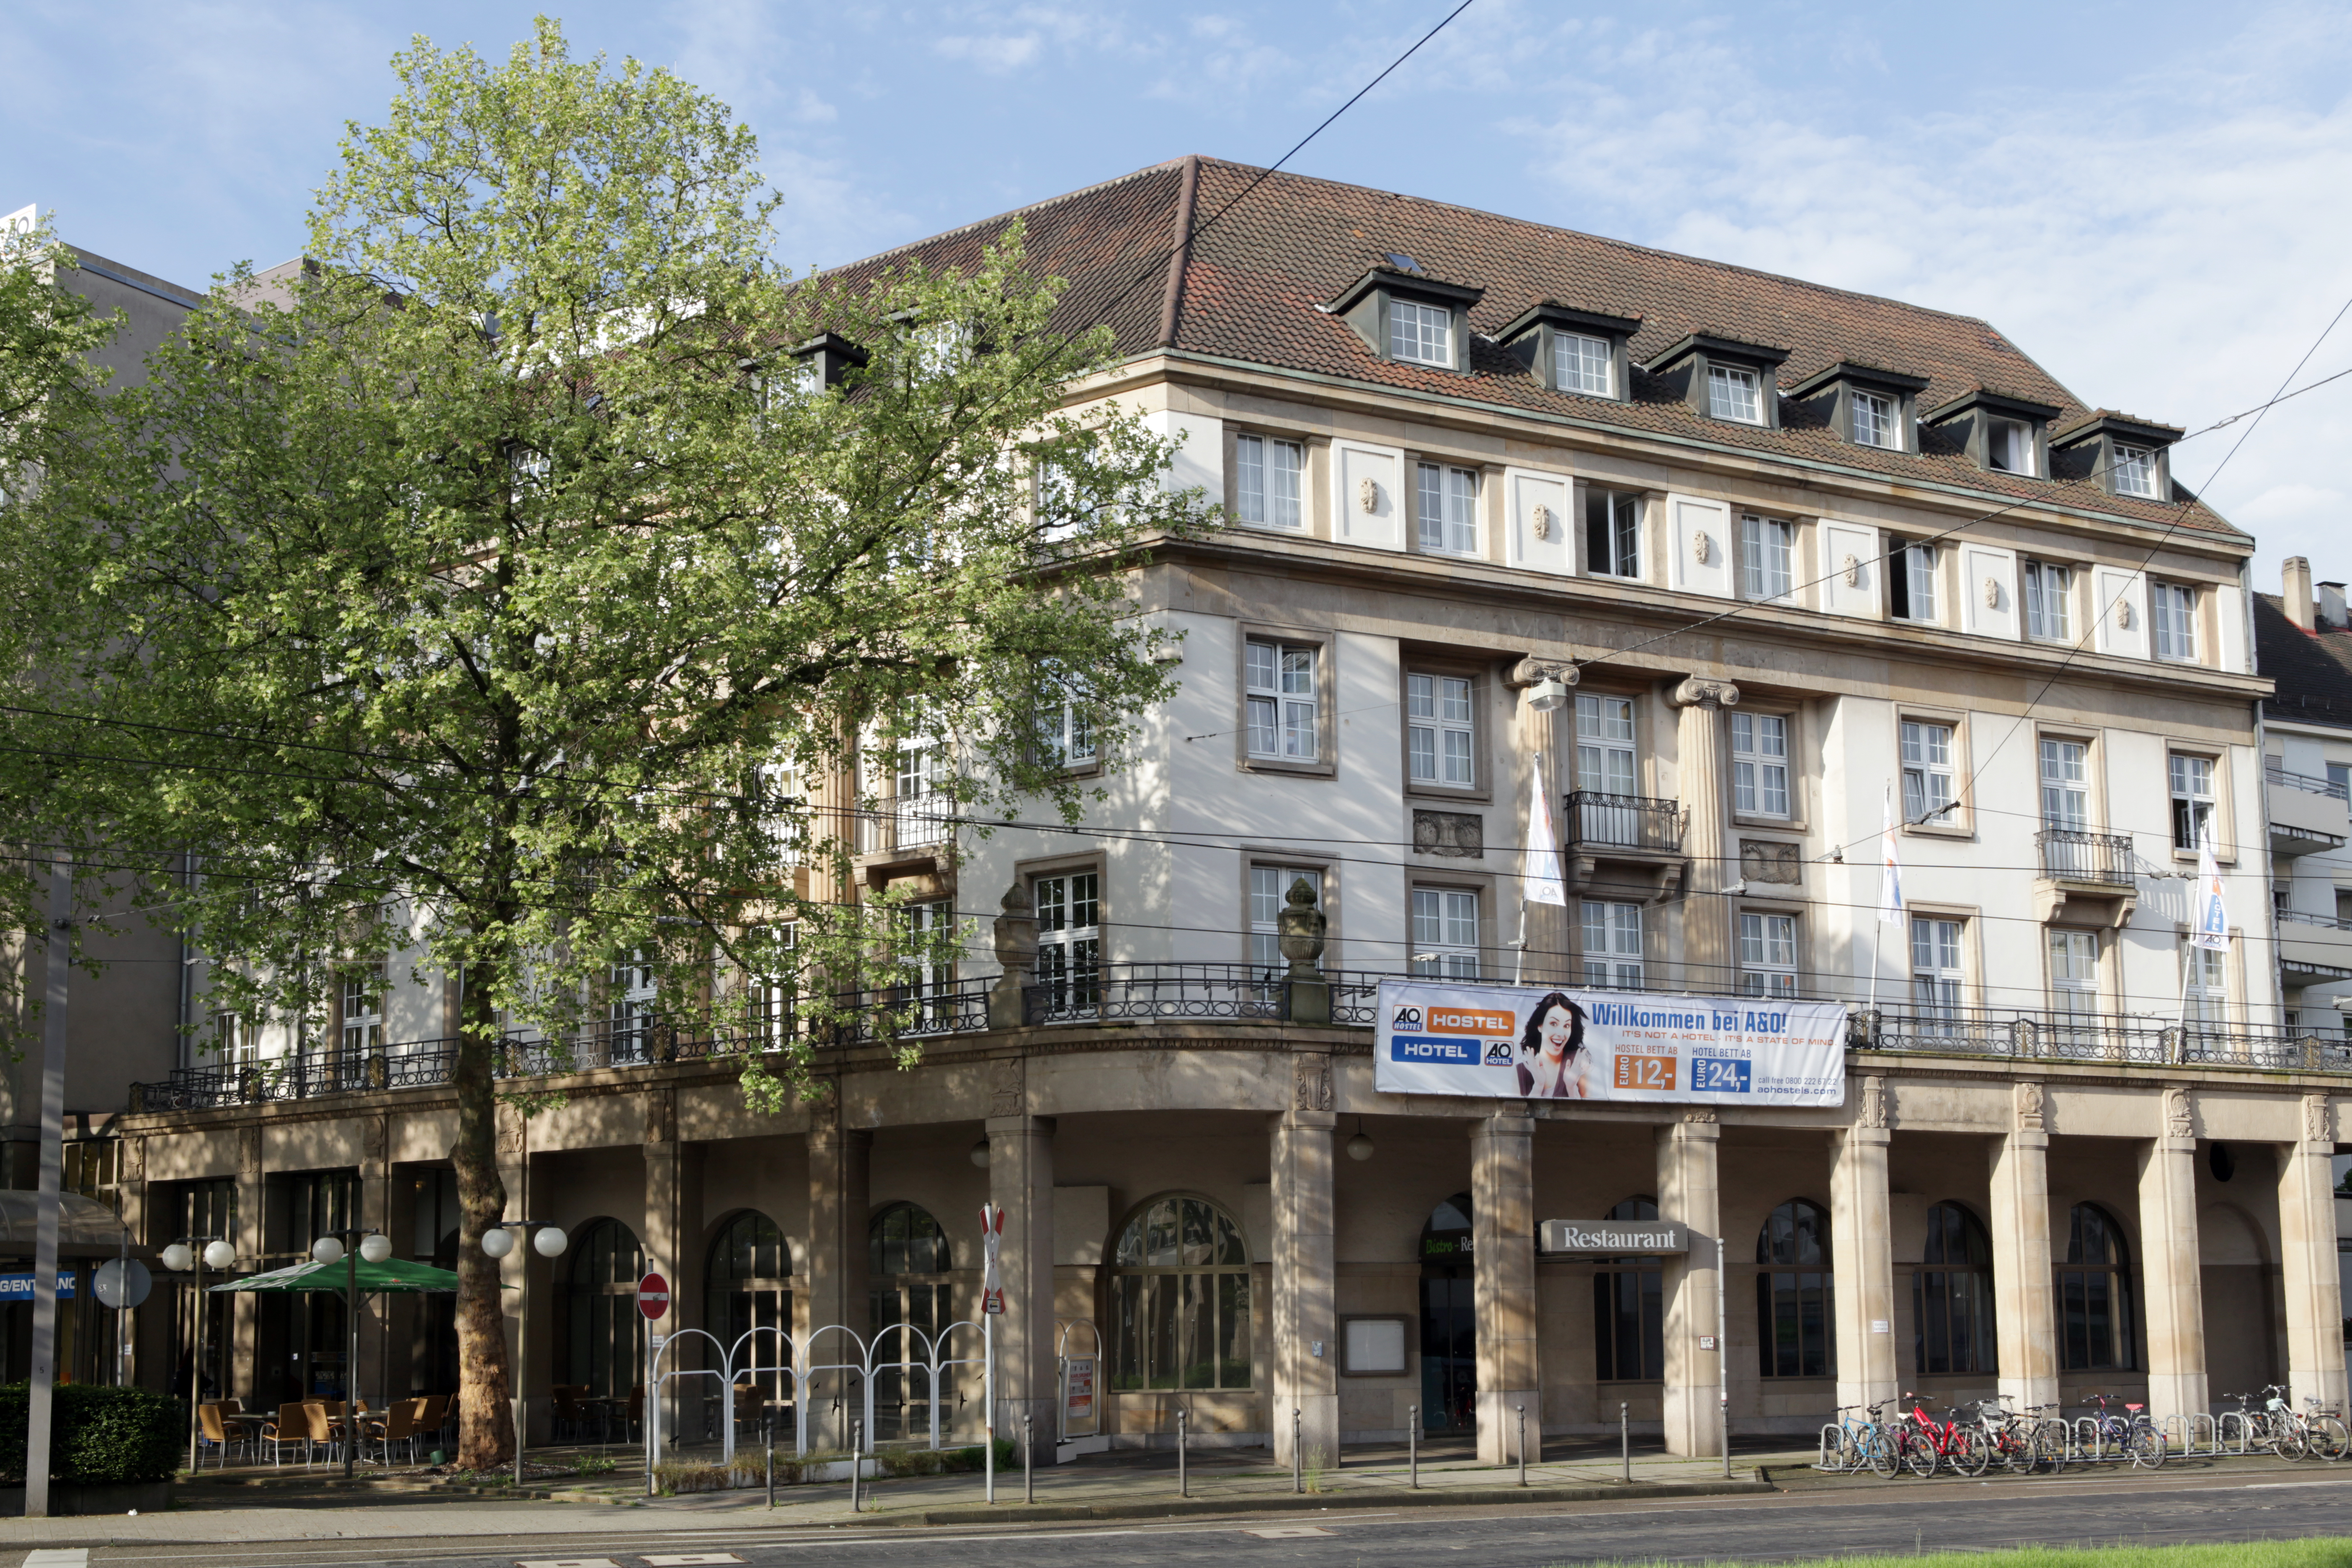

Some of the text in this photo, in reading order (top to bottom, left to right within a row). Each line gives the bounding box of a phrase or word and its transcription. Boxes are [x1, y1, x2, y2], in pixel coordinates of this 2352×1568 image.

[2212, 898, 2221, 931] HOTEL
[1433, 1014, 1509, 1029] HOSTEL
[1592, 1003, 1786, 1033] Willkommen bei A&O!
[1405, 1044, 1467, 1057] HOTEL
[1615, 1044, 1644, 1054] HOSTEL
[1647, 1045, 1665, 1054] BETT
[1692, 1047, 1751, 1058] HOTEL BETT AB
[1619, 1057, 1630, 1085] EURO
[1697, 1060, 1706, 1088] EURO
[1757, 1086, 1836, 1095] aohostels.com
[1426, 1238, 1453, 1253] Bistro
[1564, 1228, 1676, 1248] Restaurant
